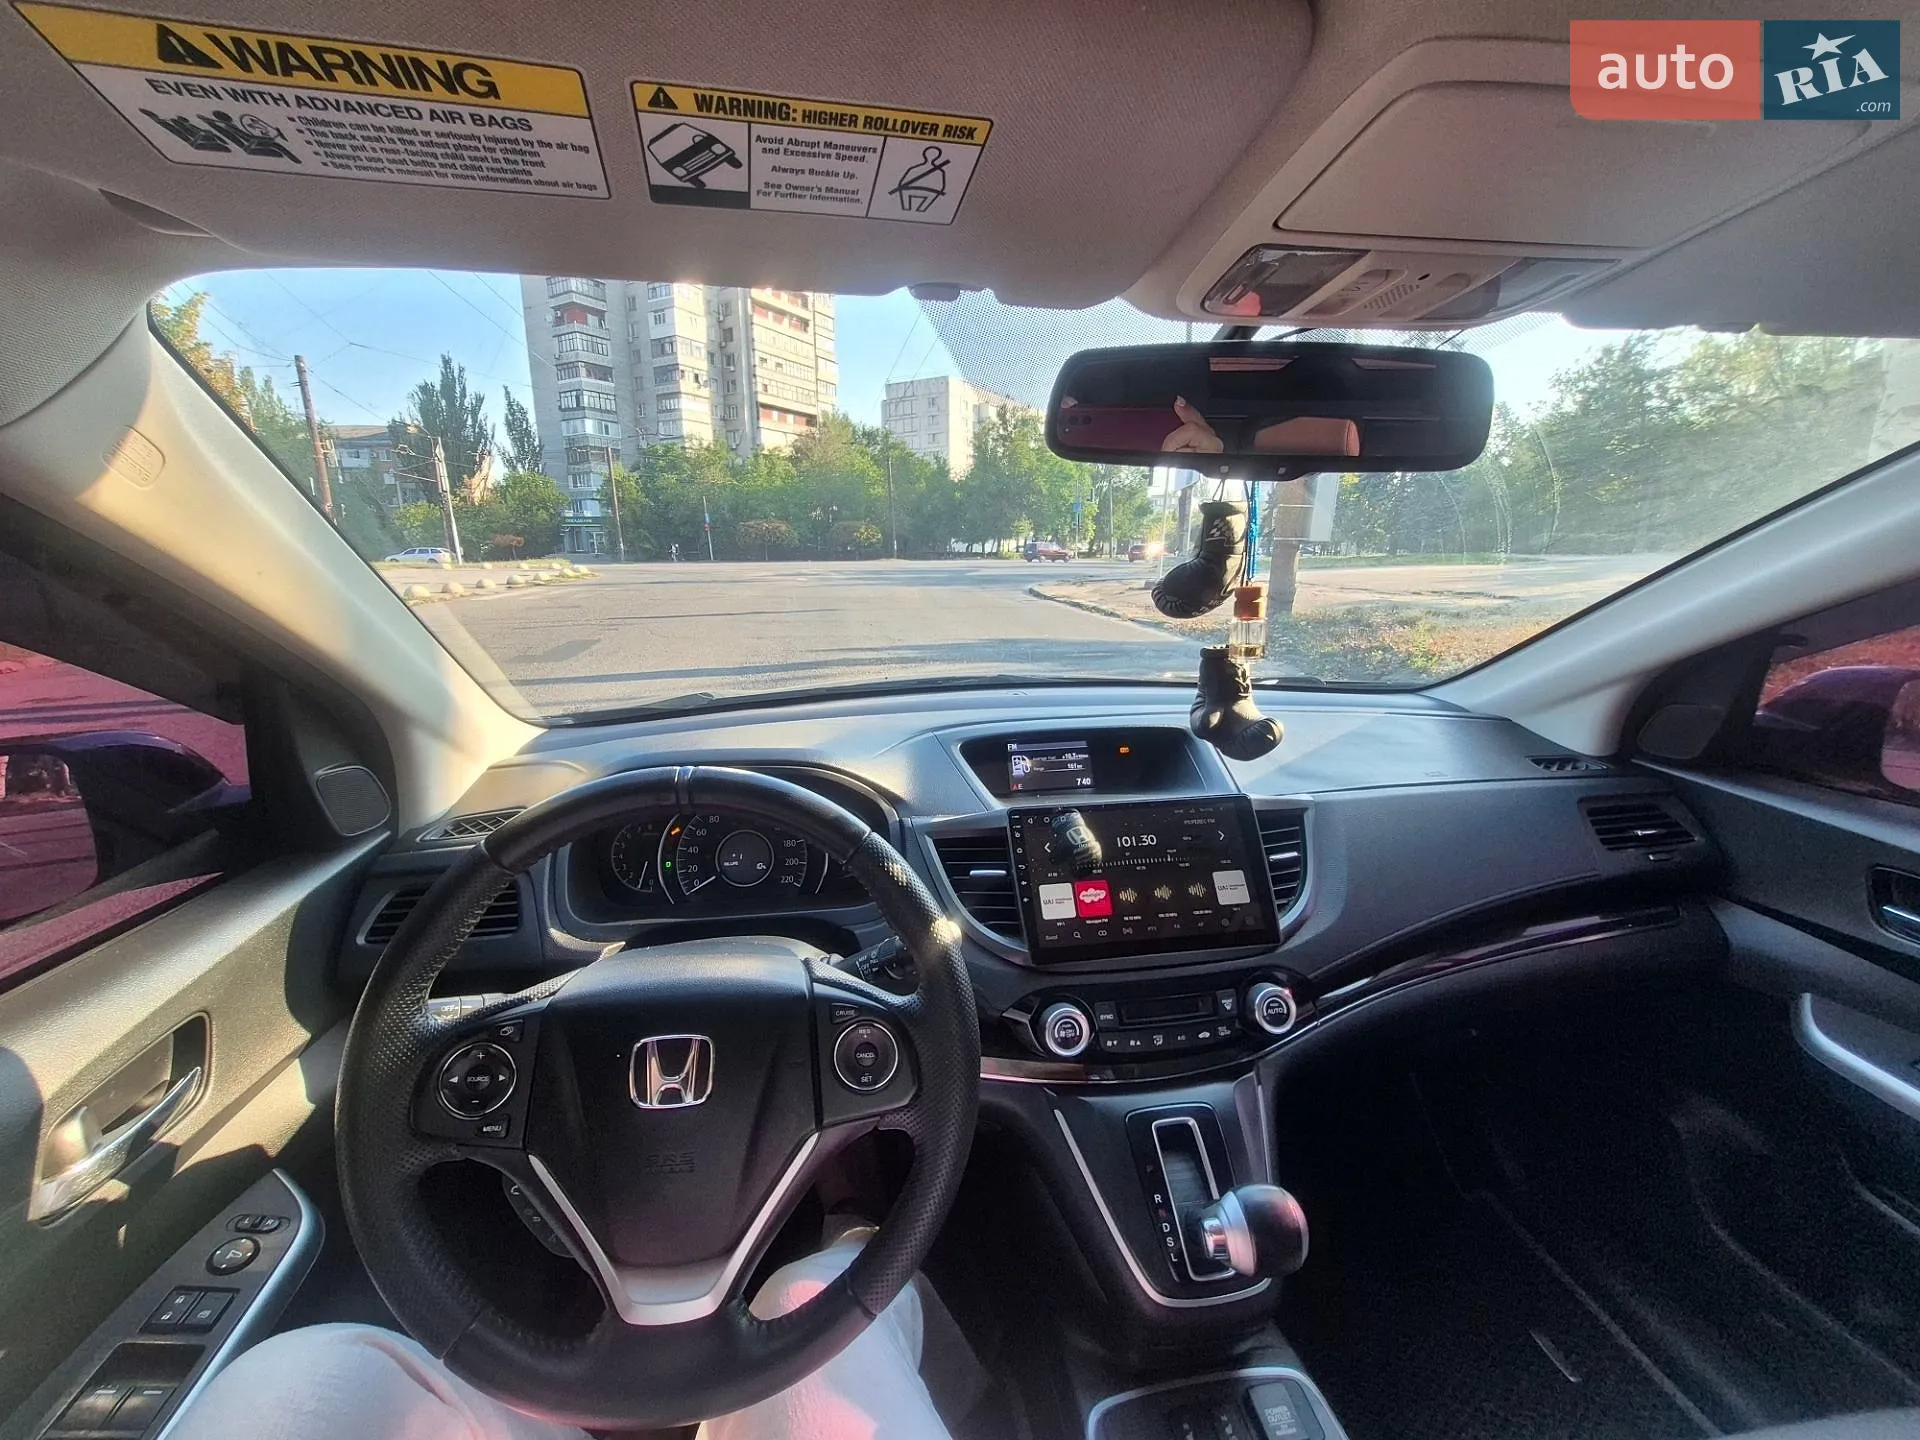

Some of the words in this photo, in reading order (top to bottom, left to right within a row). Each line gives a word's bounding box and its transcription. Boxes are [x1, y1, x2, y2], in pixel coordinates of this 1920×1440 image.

[203, 33, 502, 100] WARNING
[145, 78, 224, 100] EVEN
[220, 86, 291, 108] WITH
[294, 94, 423, 121] ADVANCED
[429, 108, 466, 125] AIR
[468, 112, 534, 132] BAGS
[693, 92, 797, 122] WARNING:
[801, 108, 858, 130] HIGHER
[862, 116, 939, 138] ROLLOVER
[943, 124, 978, 141] RISK
[298, 115, 346, 129] Children
[350, 121, 371, 132] can
[370, 123, 387, 133] be
[387, 125, 420, 136] killed
[420, 129, 432, 137] or
[435, 130, 481, 143] seriously
[484, 133, 520, 146] injured
[522, 137, 535, 149] by
[536, 139, 552, 150] the
[555, 141, 570, 151] air
[570, 143, 590, 154] bag
[307, 128, 330, 138] The
[400, 136, 417, 147] the
[483, 144, 498, 153] for
[499, 146, 541, 158] children
[755, 134, 784, 146] Avoid
[787, 137, 821, 150] Abrupt
[823, 140, 878, 154] Maneuvers
[350, 142, 368, 153] put
[440, 151, 465, 162] child
[468, 154, 489, 164] seat
[504, 157, 520, 166] the
[521, 158, 547, 168] front
[761, 146, 780, 155] and
[783, 148, 832, 160] Excessive
[834, 153, 869, 163] Speed.
[438, 160, 457, 170] and
[459, 163, 484, 173] child
[486, 165, 534, 177] restraints
[771, 165, 806, 176] Always
[808, 167, 840, 178] Buckle
[842, 170, 859, 180] Up.
[478, 172, 532, 185] information
[533, 178, 560, 188] about
[561, 180, 574, 189] air
[576, 181, 598, 191] bags
[763, 181, 782, 190] See
[785, 183, 823, 193] Owner's
[825, 186, 860, 196] Manual
[756, 189, 772, 197] For
[774, 190, 807, 200] Further
[708, 815, 720, 823] 80
[695, 828, 707, 837] 60
[783, 840, 797, 848] 180
[1116, 834, 1157, 847] 101.30
[687, 845, 699, 854] 40
[784, 857, 799, 866] 200
[687, 864, 698, 873] 20
[693, 879, 700, 887] 0
[780, 875, 794, 884] 220
[1267, 1007, 1283, 1015] AUTO
[860, 1075, 872, 1083] SET
[1154, 1194, 1163, 1204] R
[1162, 1223, 1171, 1233] D
[1166, 1236, 1175, 1247] S
[1170, 1253, 1178, 1262] L
[1264, 1405, 1289, 1416] POWER
